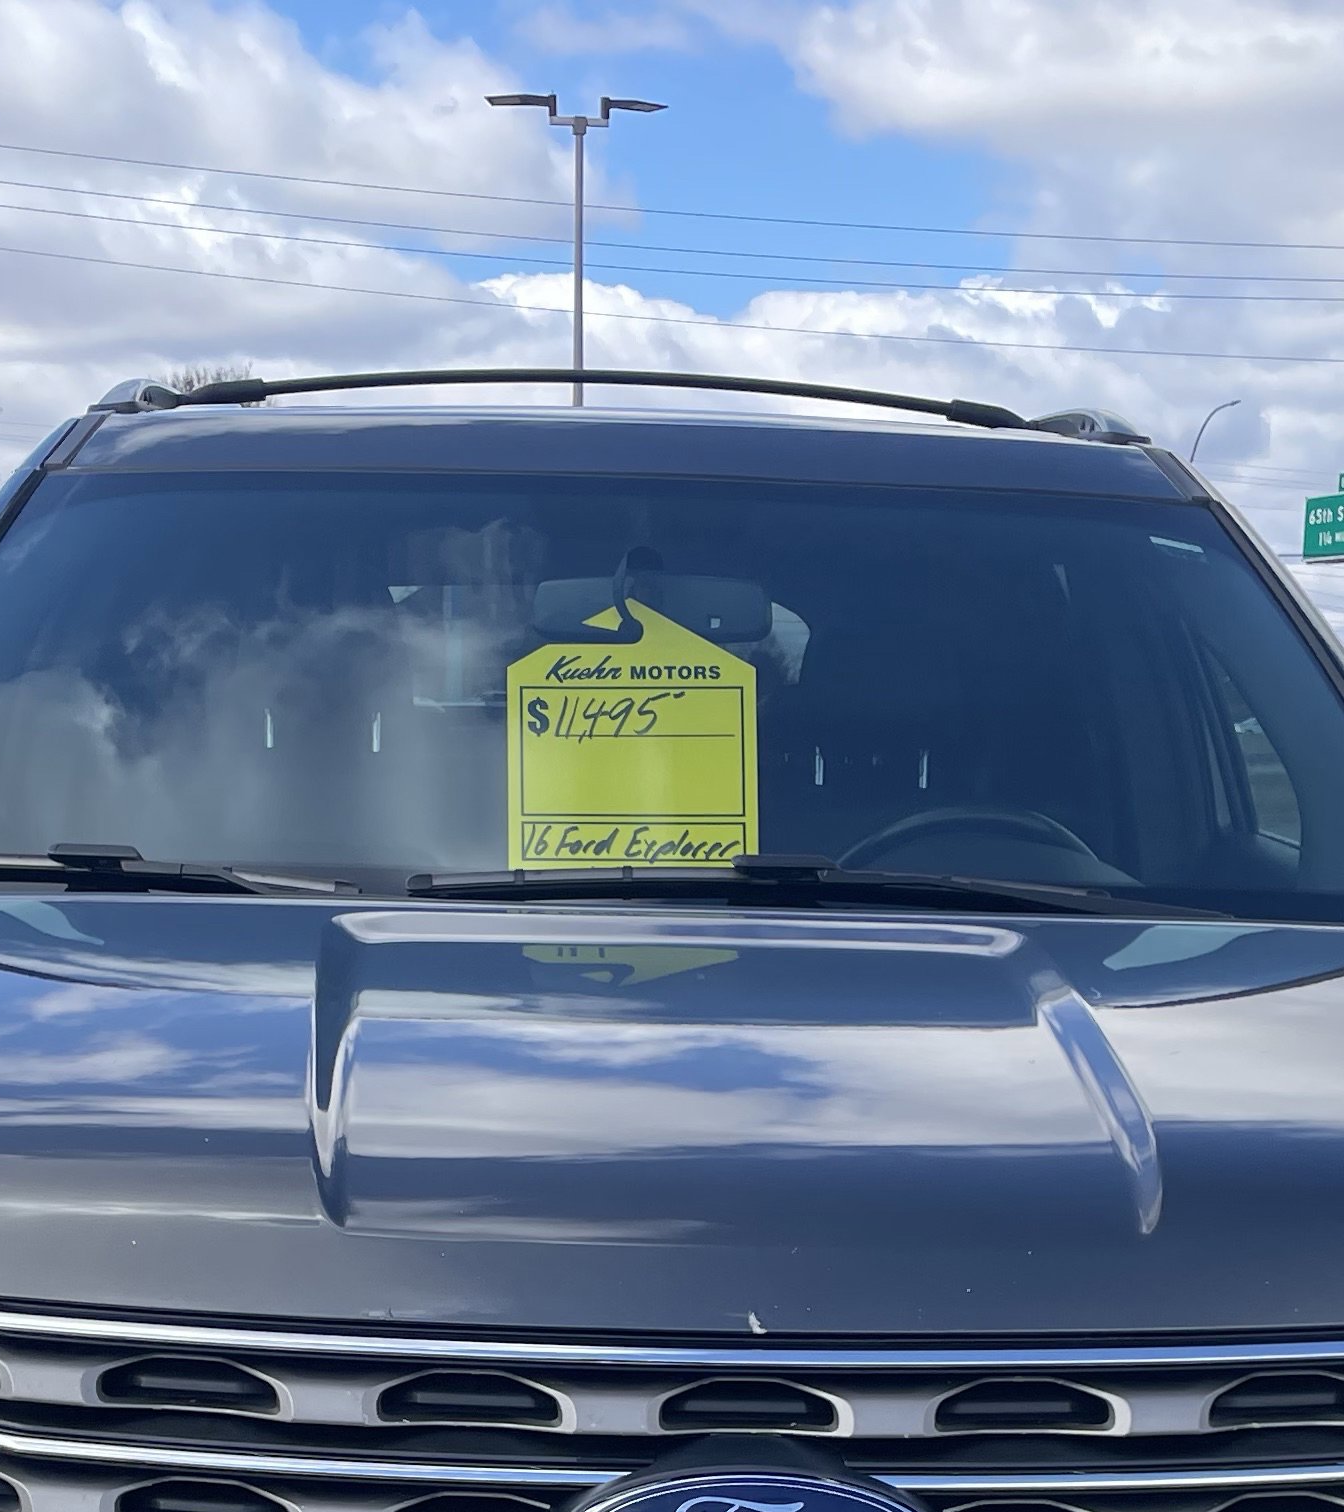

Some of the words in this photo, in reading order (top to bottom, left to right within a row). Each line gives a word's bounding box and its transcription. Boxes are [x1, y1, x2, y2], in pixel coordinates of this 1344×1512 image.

[1308, 508, 1333, 525] 65th
[545, 655, 623, 683] Kuehn
[630, 665, 721, 680] MOTORS
[556, 825, 619, 856] Ford
[624, 826, 741, 864] Explorer
